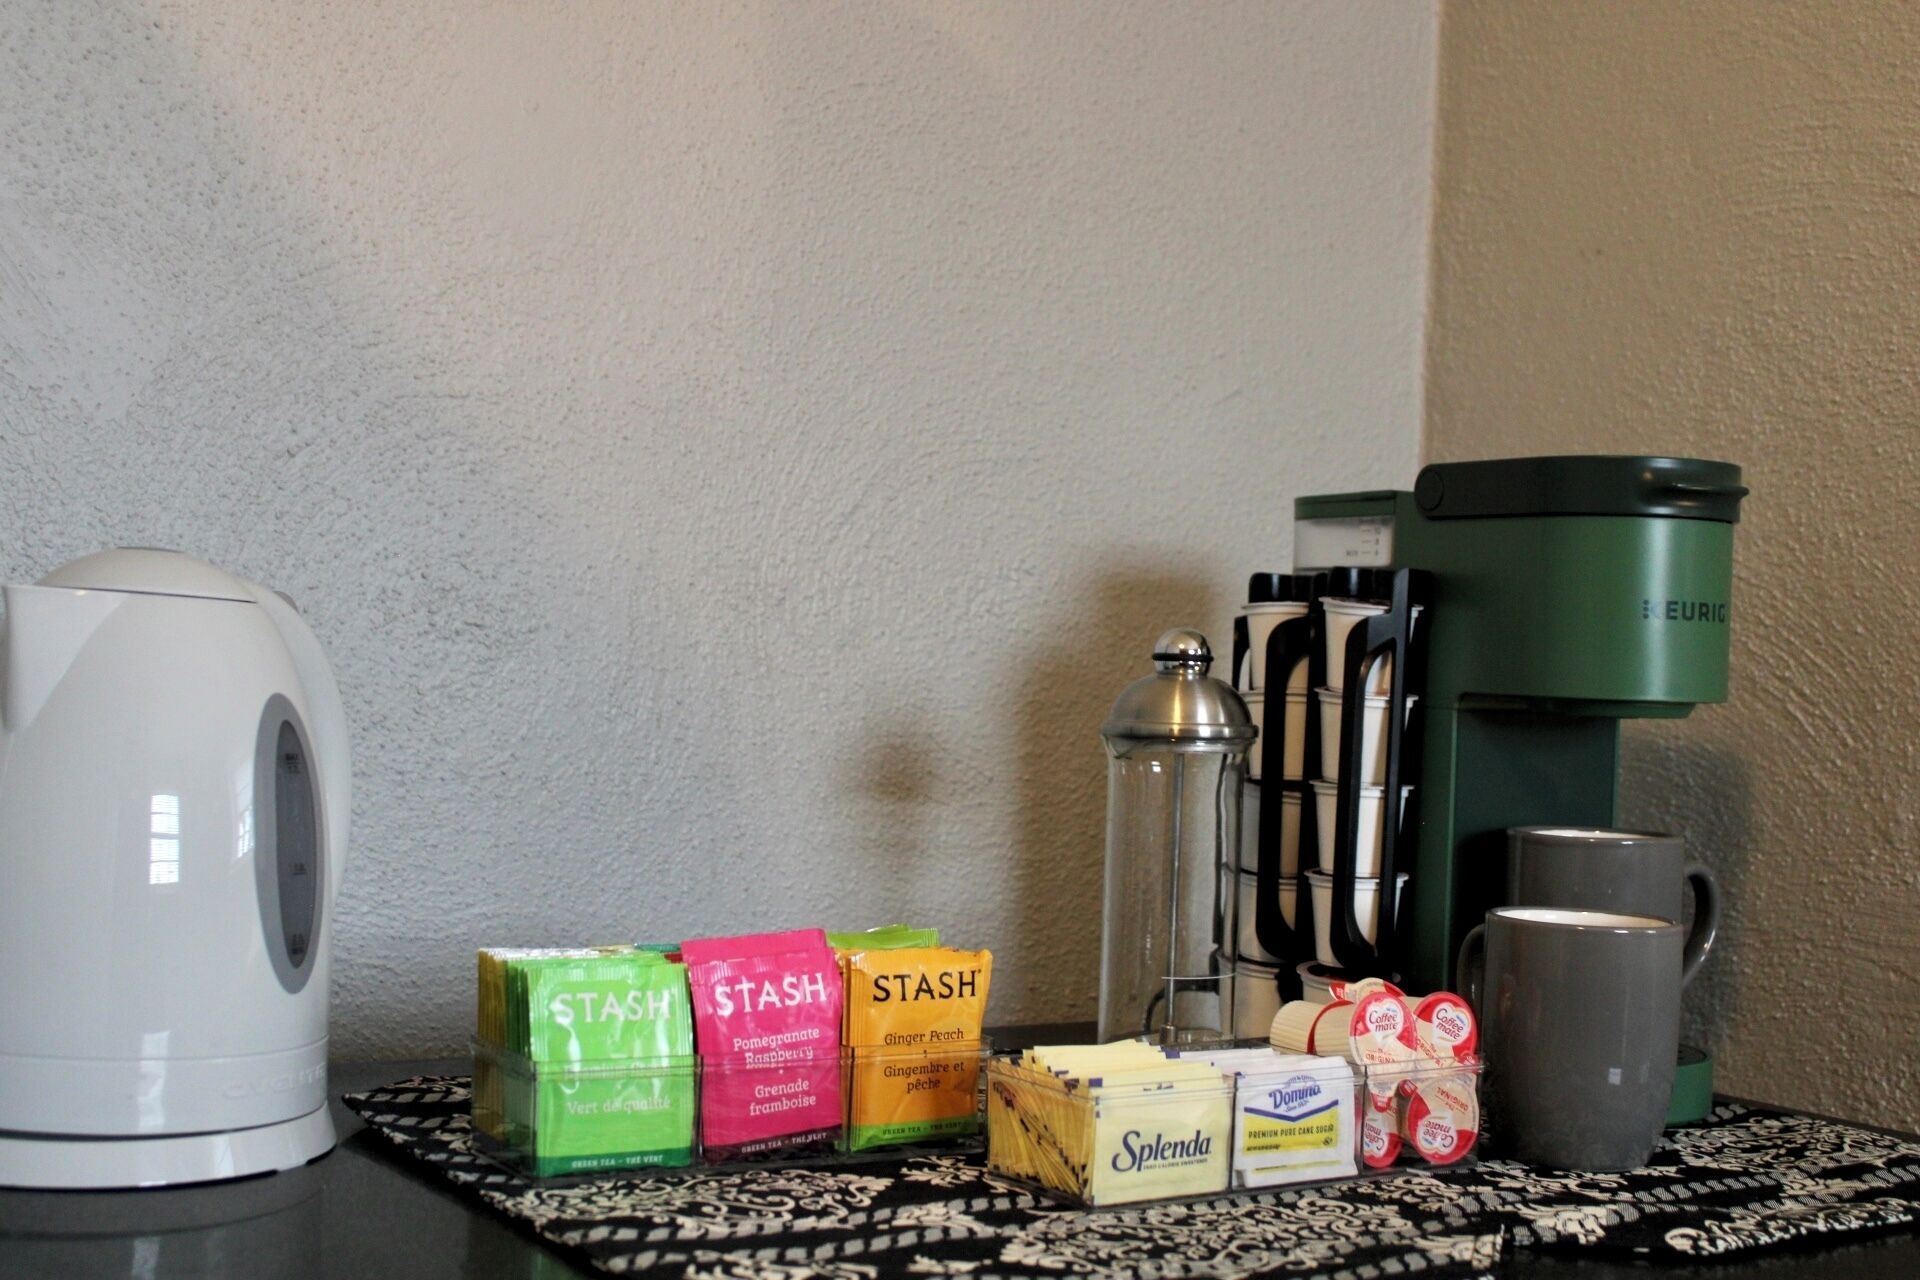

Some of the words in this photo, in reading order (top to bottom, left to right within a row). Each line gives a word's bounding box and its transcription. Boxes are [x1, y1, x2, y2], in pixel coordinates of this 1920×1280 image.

[1642, 599, 1726, 624] KEURIG
[715, 972, 827, 1018] STASH
[872, 970, 977, 1003] STASH
[548, 989, 672, 1026] STASH
[1368, 1009, 1397, 1025] Coffee
[1375, 1021, 1399, 1033] mate
[1435, 1007, 1464, 1033] Coffee
[733, 1027, 821, 1052] Pomegranate
[884, 1032, 926, 1047] Ginger
[929, 1027, 965, 1042] Peach
[1435, 1022, 1461, 1040] mate
[745, 1045, 815, 1068] Raspberry
[884, 1062, 949, 1079] Gingembre
[953, 1061, 965, 1072] et
[754, 1079, 810, 1100] Grenade
[906, 1076, 941, 1094] pêche
[566, 1101, 598, 1116] Vert
[603, 1098, 620, 1113] de
[623, 1095, 671, 1116] qualité
[749, 1093, 818, 1117] framboise
[1268, 1084, 1322, 1110] Domino
[1437, 1086, 1469, 1112] ORIGINAL
[1248, 1130, 1279, 1139] PREMIUM
[1280, 1127, 1296, 1137] PURE
[1298, 1126, 1314, 1135] CANE
[1315, 1123, 1334, 1134] SUGAR
[1424, 1121, 1452, 1134] mate
[741, 1143, 766, 1154] GREEN
[768, 1140, 782, 1149] TEA
[1111, 1129, 1211, 1173] Splenda
[571, 1159, 598, 1169] GREEN
[600, 1157, 615, 1167] TEA
[644, 1154, 664, 1164] VERT
